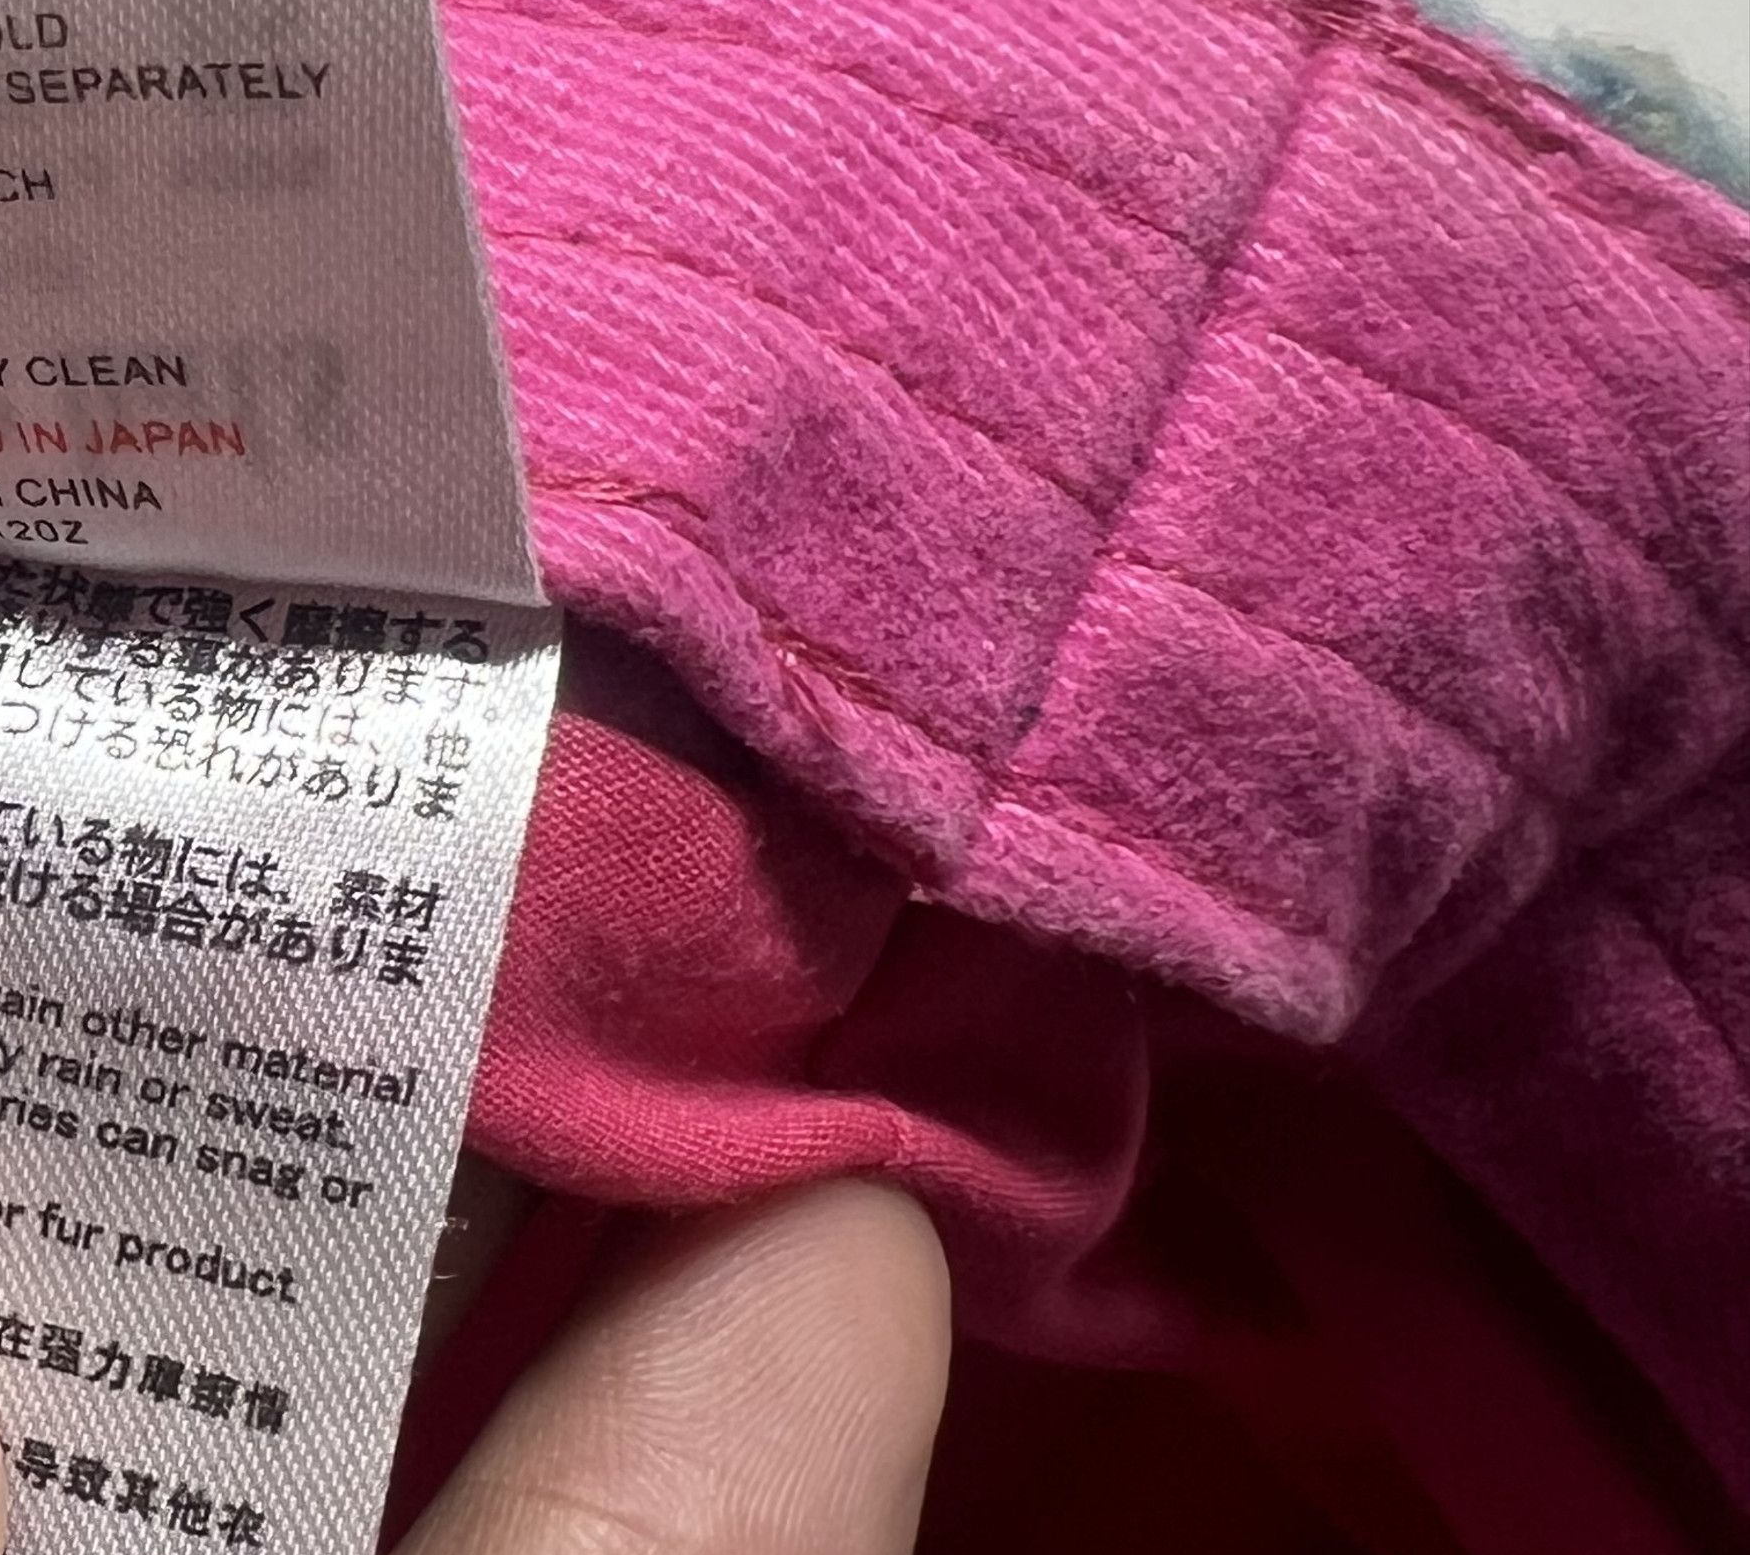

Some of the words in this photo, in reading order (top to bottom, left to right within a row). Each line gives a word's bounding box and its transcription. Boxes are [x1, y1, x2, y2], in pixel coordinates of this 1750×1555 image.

[6, 61, 332, 106] SEPARATELY
[25, 353, 188, 389] CLEAN
[17, 420, 69, 455] IN
[85, 418, 247, 458] JAPAN
[15, 477, 164, 512] CHINA
[38, 1049, 122, 1096] rain
[140, 1076, 192, 1109] or
[82, 1006, 208, 1059] other
[222, 1040, 421, 1108] material
[96, 1120, 179, 1165] can
[195, 1143, 306, 1201] snag
[320, 1174, 375, 1209] or
[38, 1200, 104, 1251] fur
[114, 1232, 297, 1305] product
